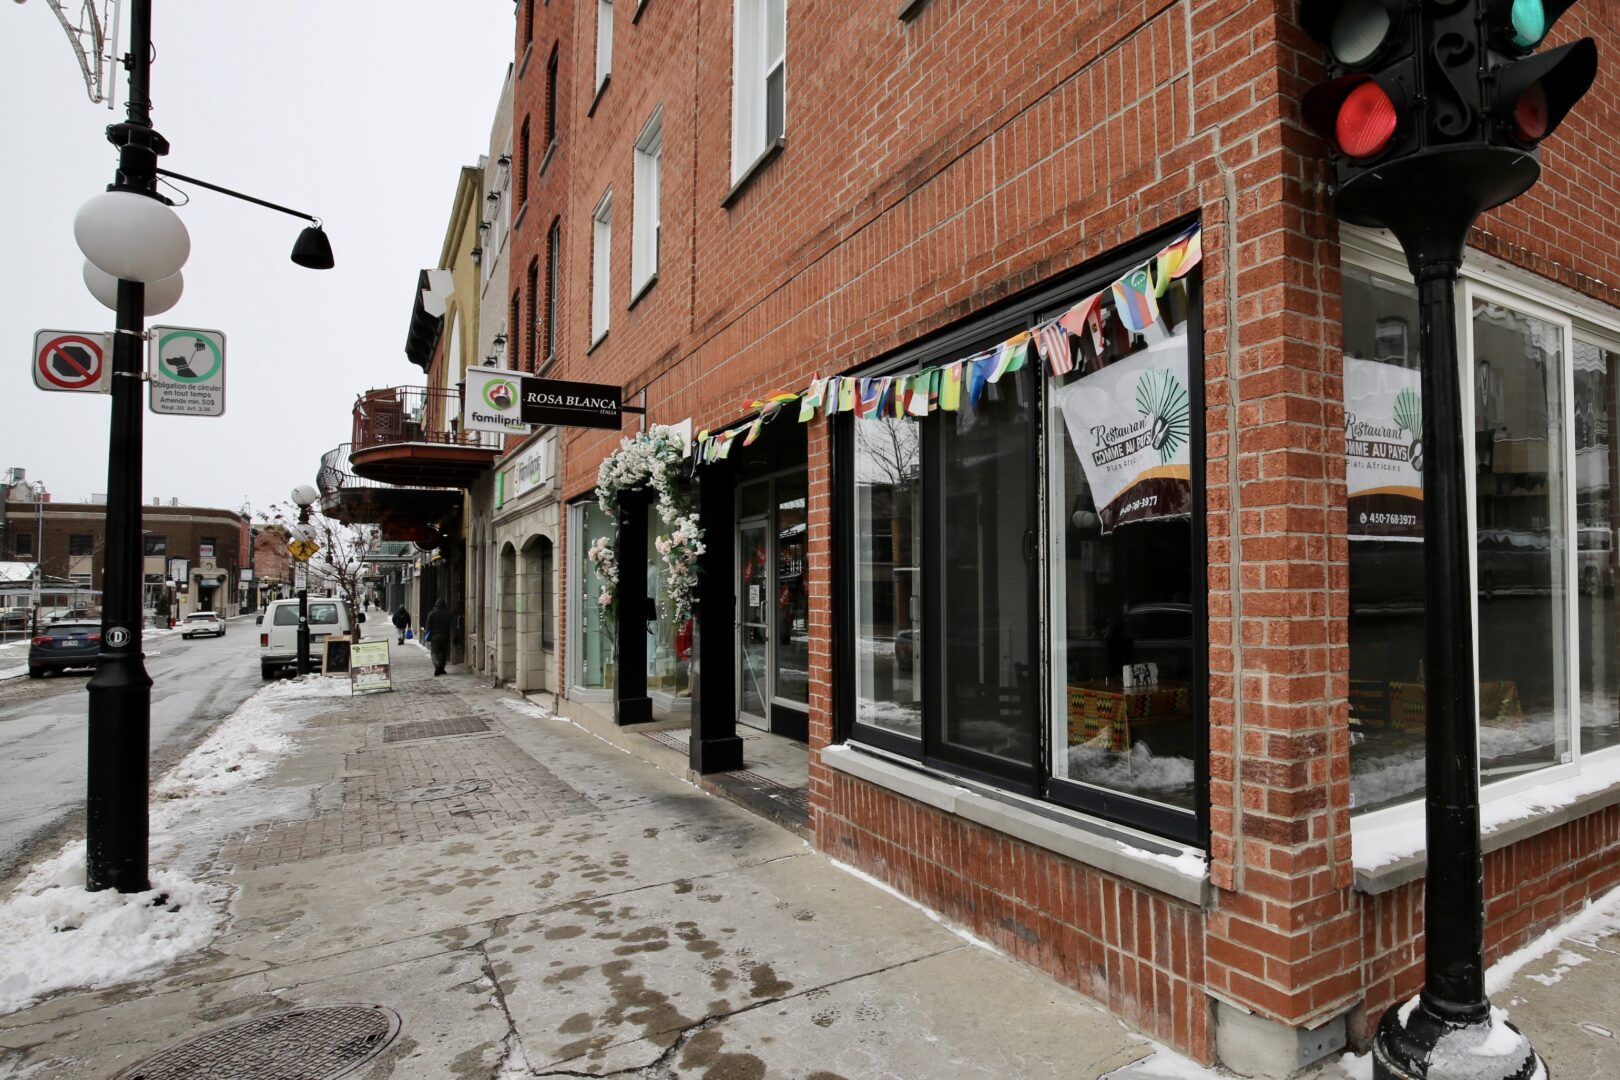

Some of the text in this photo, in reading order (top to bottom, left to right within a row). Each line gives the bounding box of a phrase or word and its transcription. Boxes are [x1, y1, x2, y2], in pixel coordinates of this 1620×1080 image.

[152, 381, 187, 390] Obligation
[527, 392, 617, 410] ROSA BLANCA
[599, 408, 617, 416] ITALIA
[1344, 411, 1403, 440] Restaurant
[1094, 443, 1125, 465] COMME
[1345, 439, 1408, 461] MME AU PAYS
[113, 631, 123, 643] D
